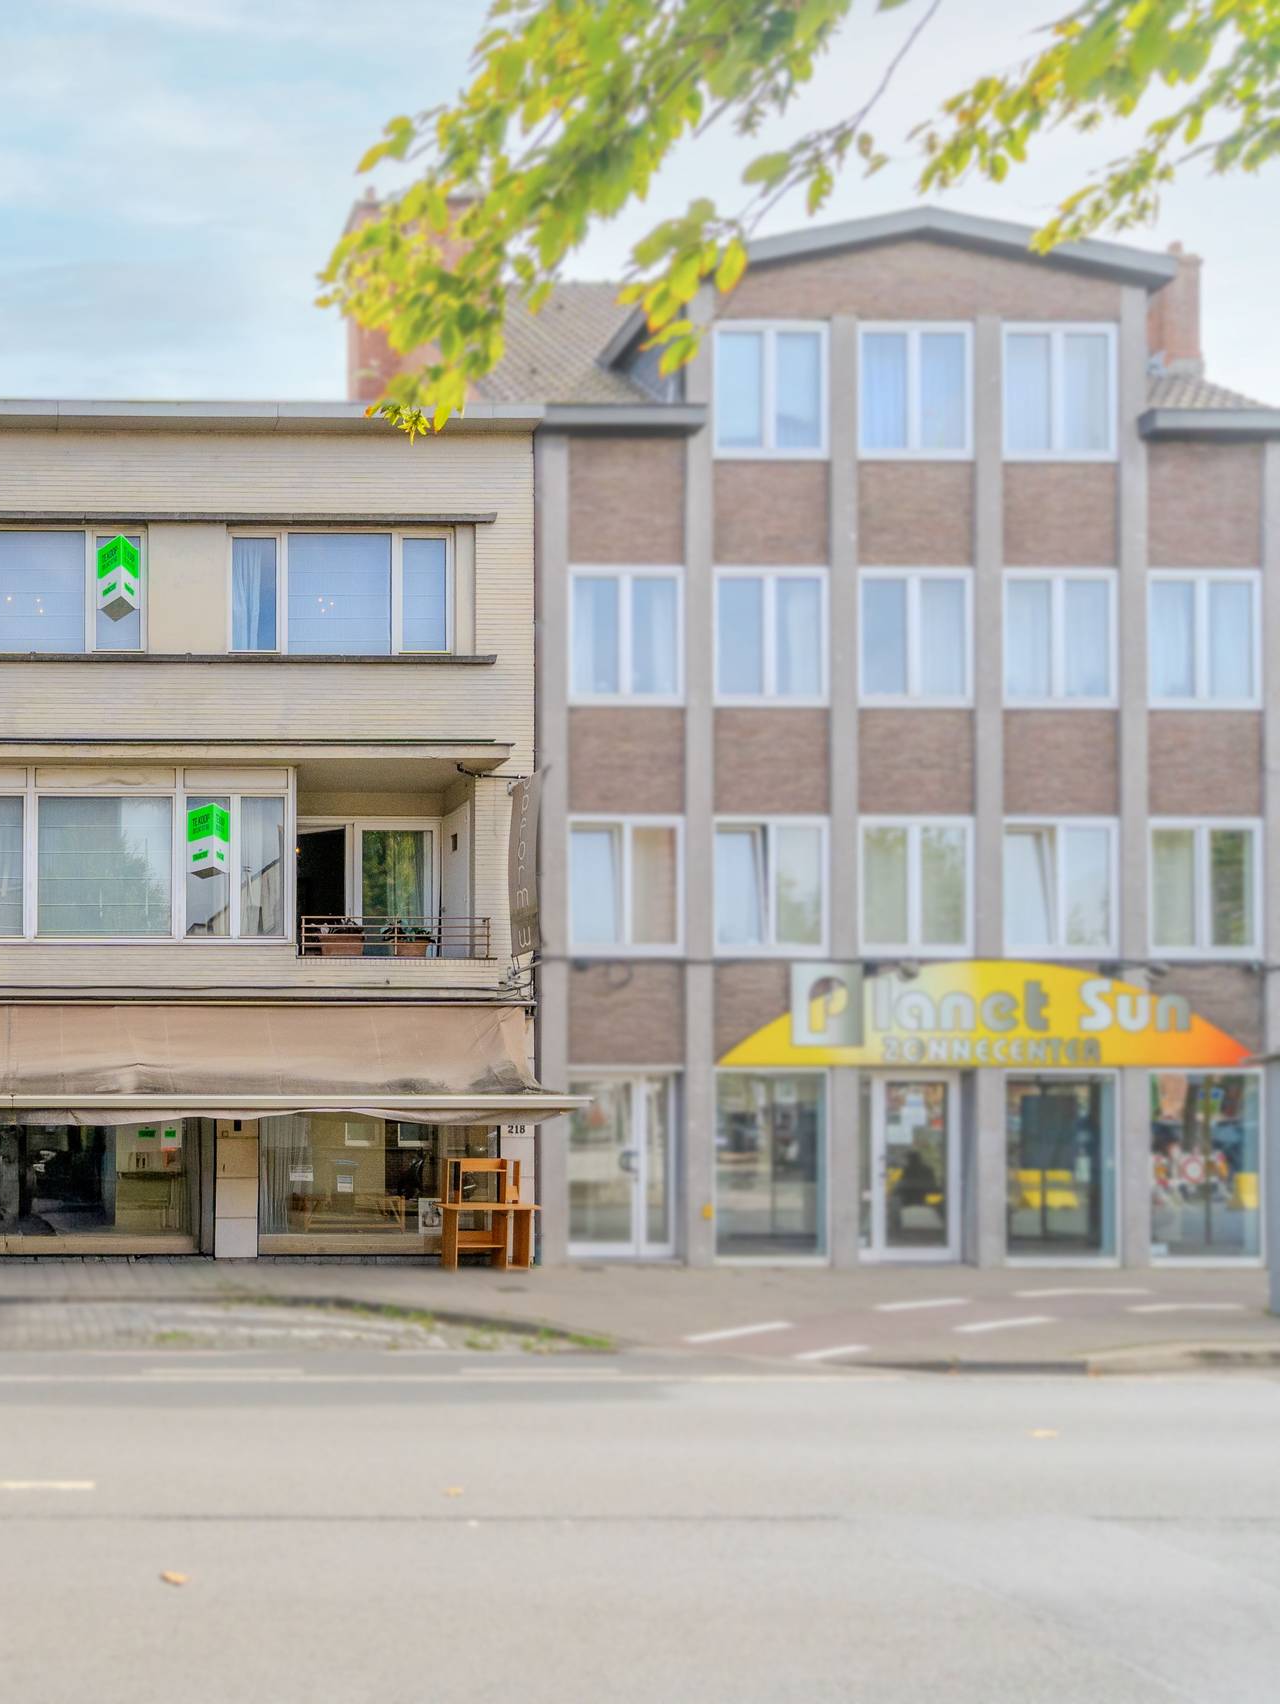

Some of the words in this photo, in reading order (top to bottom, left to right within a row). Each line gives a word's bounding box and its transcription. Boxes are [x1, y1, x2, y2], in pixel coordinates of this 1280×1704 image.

[1079, 978, 1191, 1033] Sun
[882, 1037, 1102, 1063] ZONNECENTER
[507, 1124, 526, 1134] 218
